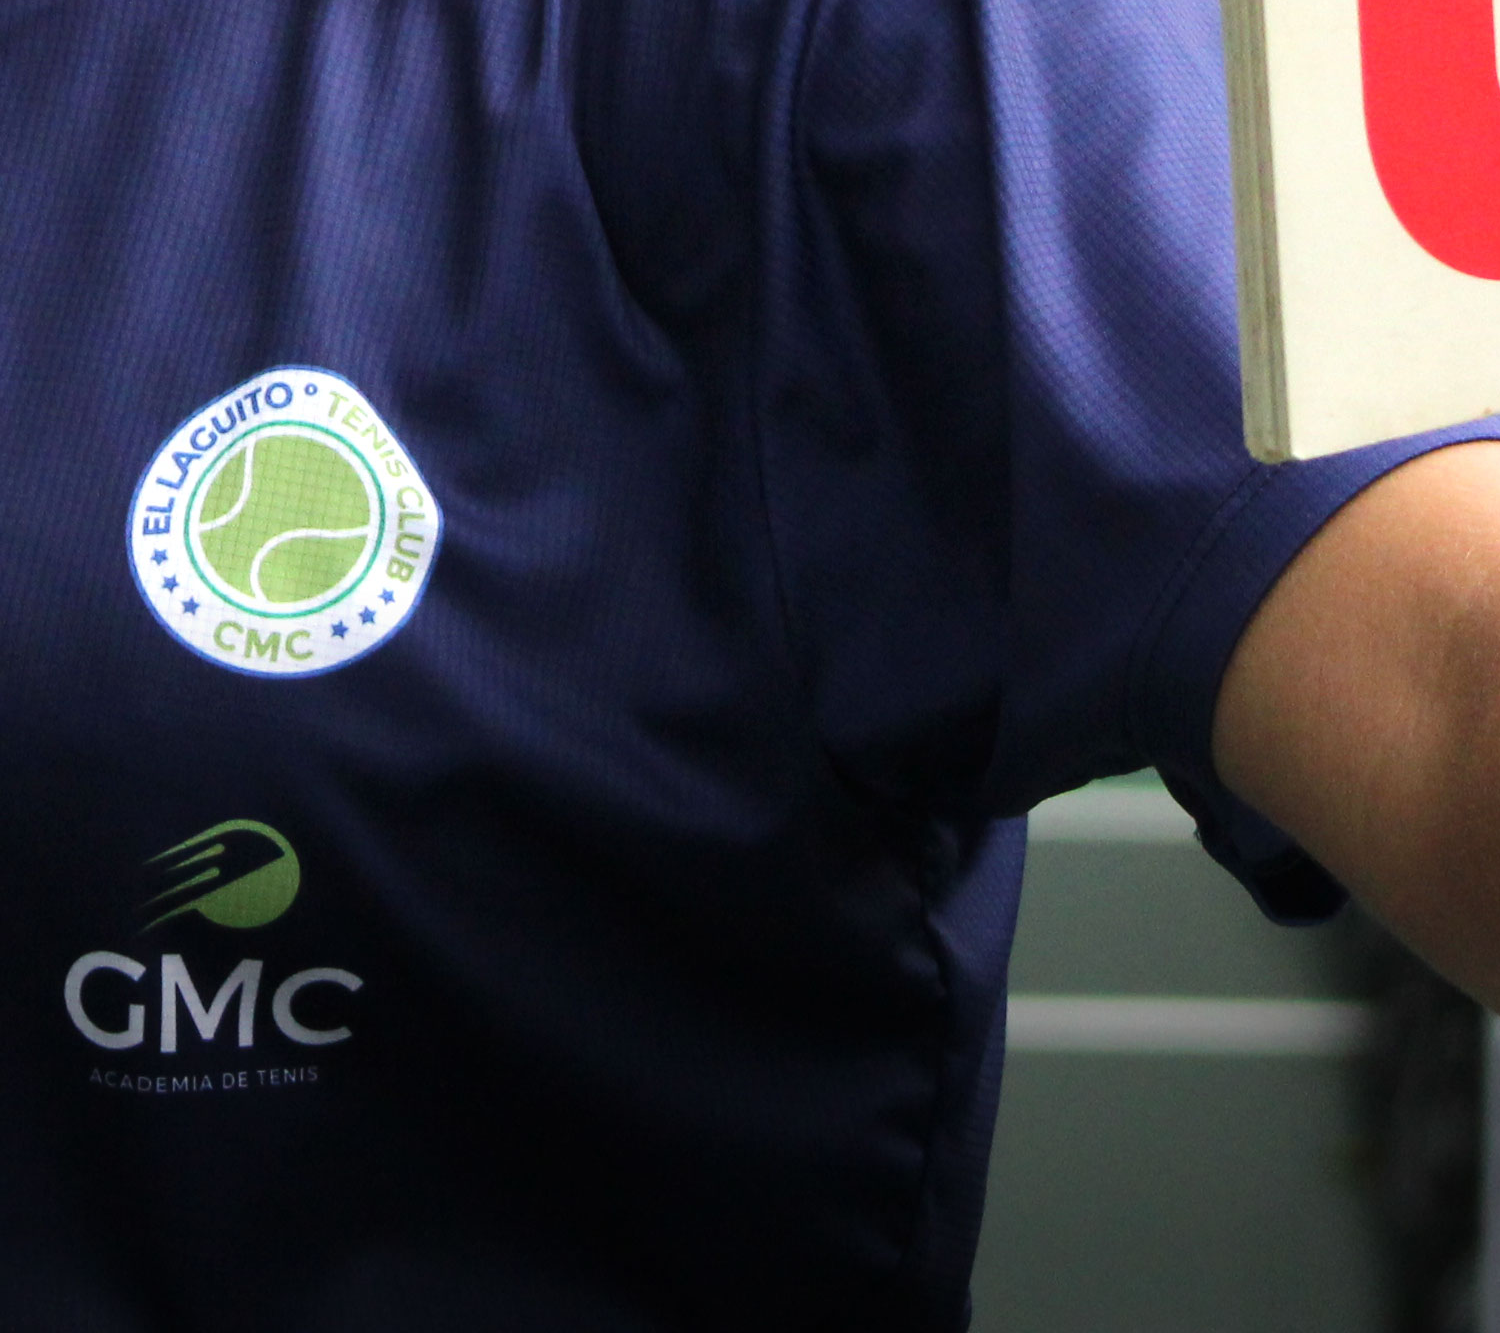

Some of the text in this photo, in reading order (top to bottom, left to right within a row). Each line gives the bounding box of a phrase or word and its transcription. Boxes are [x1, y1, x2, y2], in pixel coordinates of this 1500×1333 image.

[142, 382, 293, 536] EL LAGUITO
[328, 391, 425, 584] TENIS CLUB
[213, 620, 314, 662] CMC
[64, 950, 364, 1053] GMC
[89, 1066, 319, 1093] ACADEMIA DE TENIS
